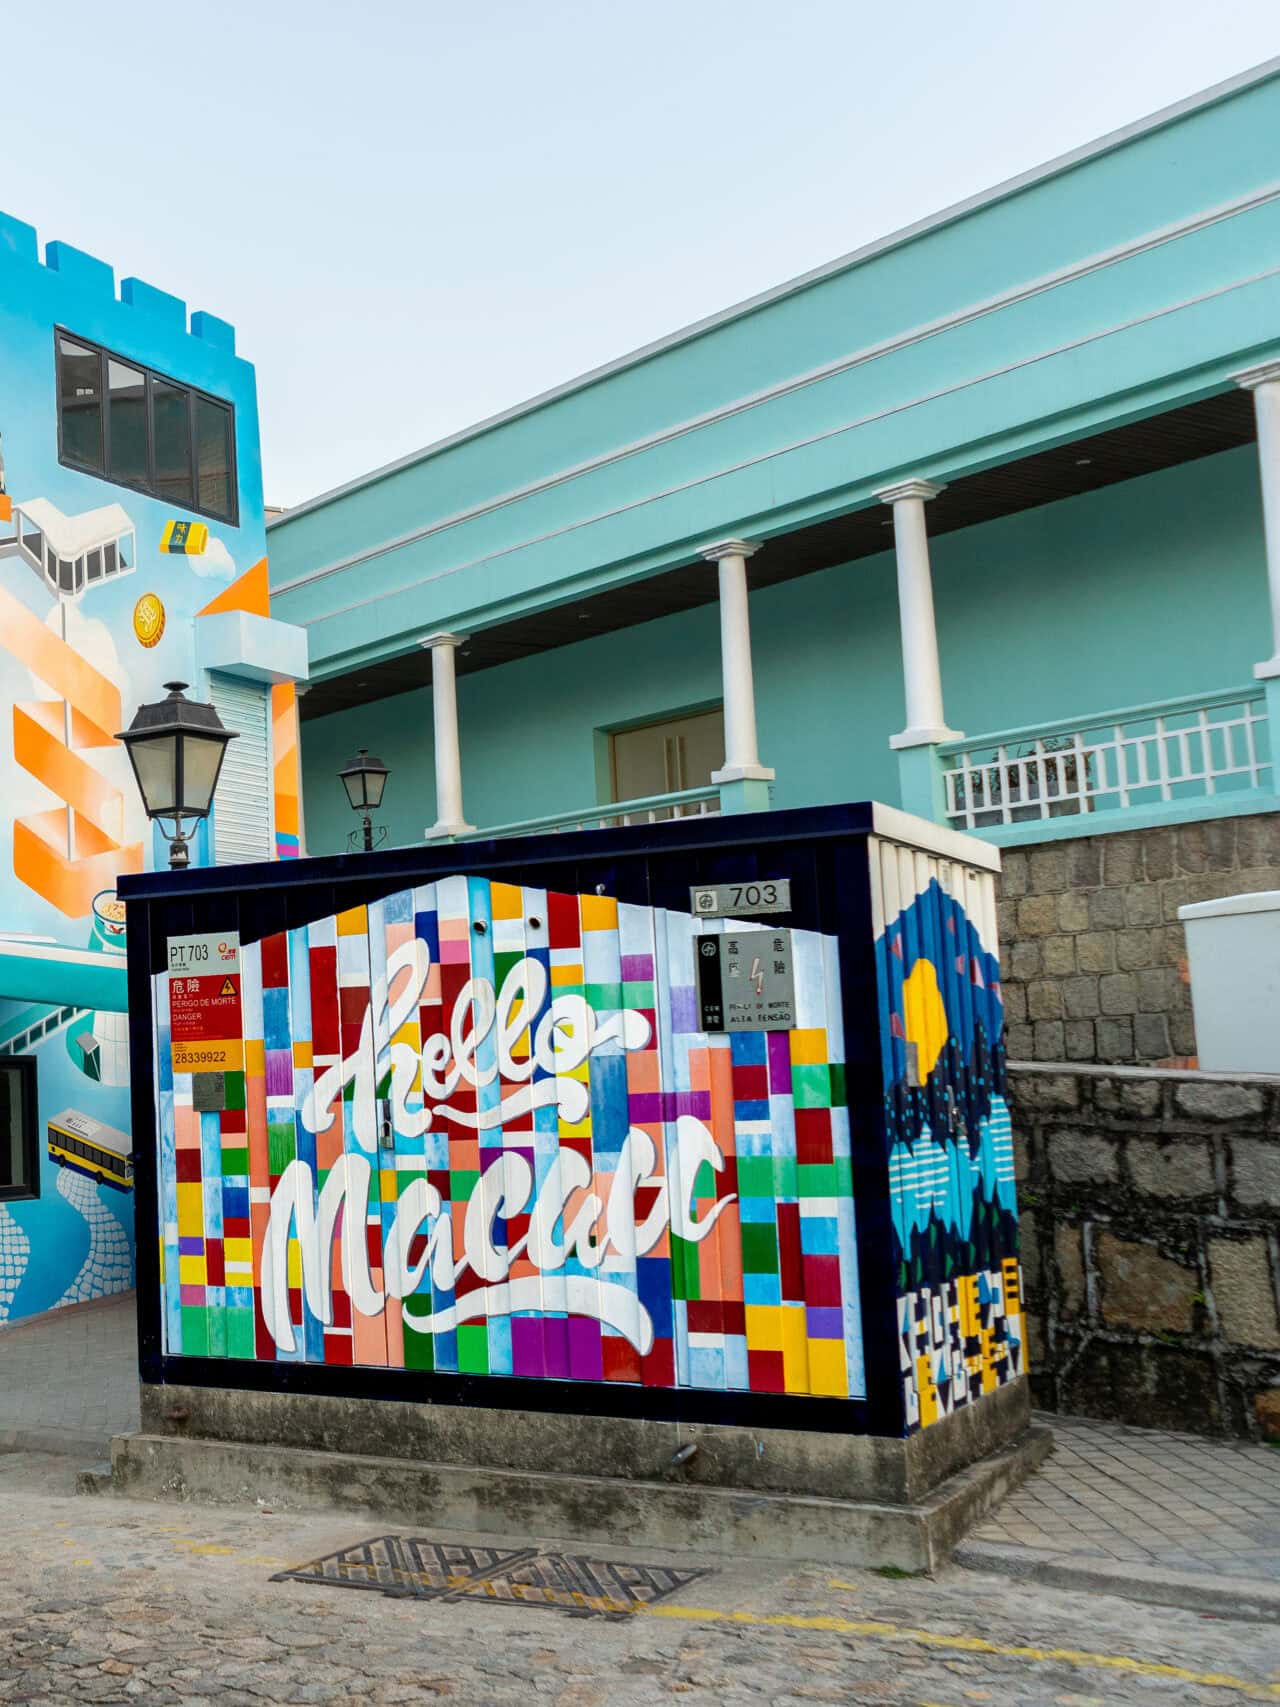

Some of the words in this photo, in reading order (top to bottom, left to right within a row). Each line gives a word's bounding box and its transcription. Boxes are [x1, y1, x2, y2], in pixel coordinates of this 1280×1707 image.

[729, 884, 778, 907] 703
[170, 945, 186, 963] PT
[188, 944, 209, 961] 703
[173, 979, 200, 994] 危險
[172, 999, 199, 1008] PERIGO
[200, 999, 210, 1007] DE
[211, 997, 237, 1006] MORTE
[173, 1012, 202, 1022] DANGER
[302, 938, 651, 1153] hello
[175, 1051, 226, 1065] 28339922
[261, 1115, 737, 1353] Macau
